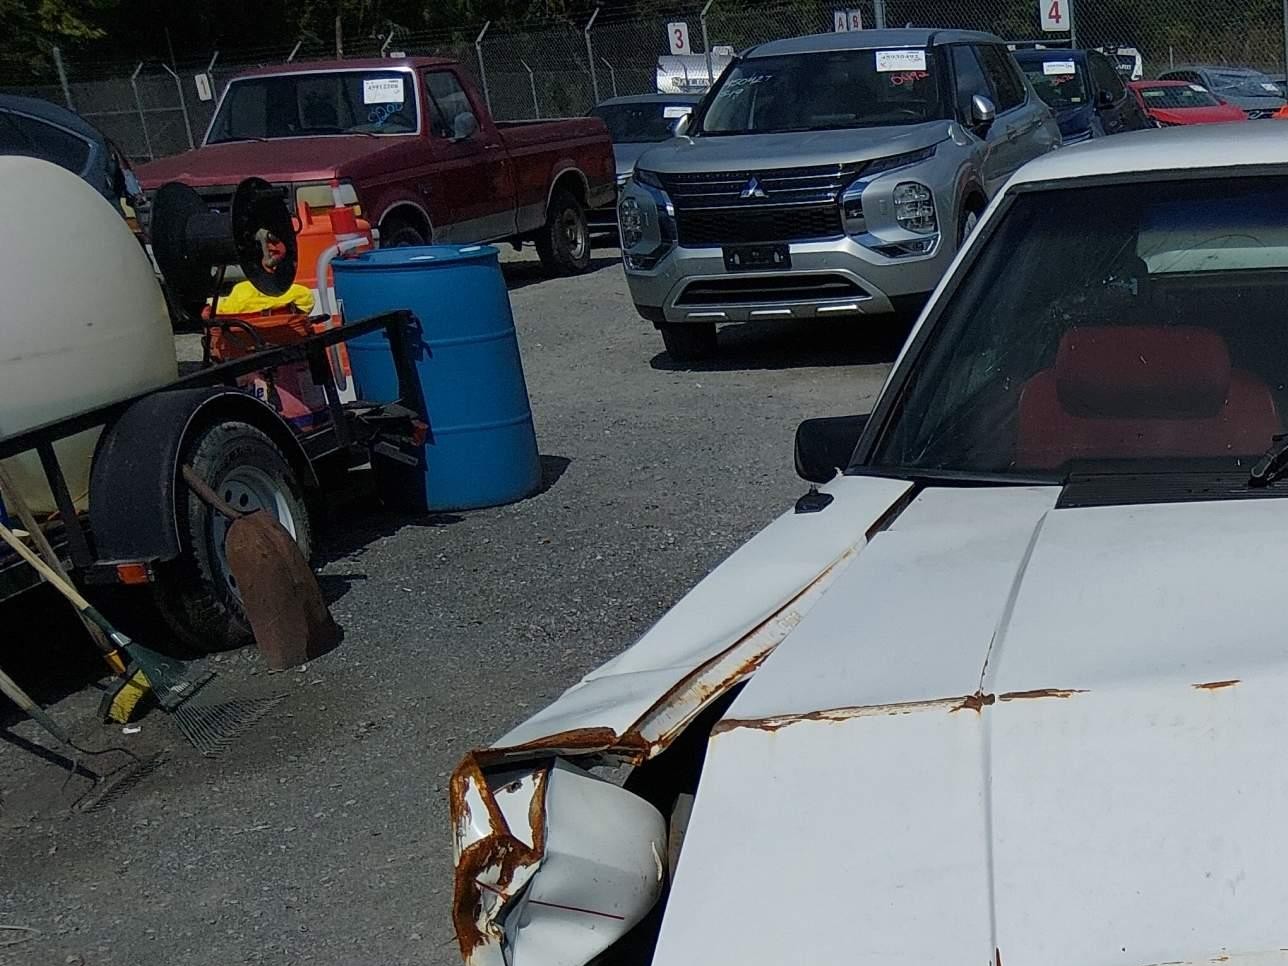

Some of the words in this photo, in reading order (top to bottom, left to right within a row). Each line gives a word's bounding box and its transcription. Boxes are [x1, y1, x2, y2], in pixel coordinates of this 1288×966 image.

[1048, 1, 1062, 24] 4
[838, 16, 845, 30] A
[852, 15, 859, 28] B
[674, 28, 684, 49] 3
